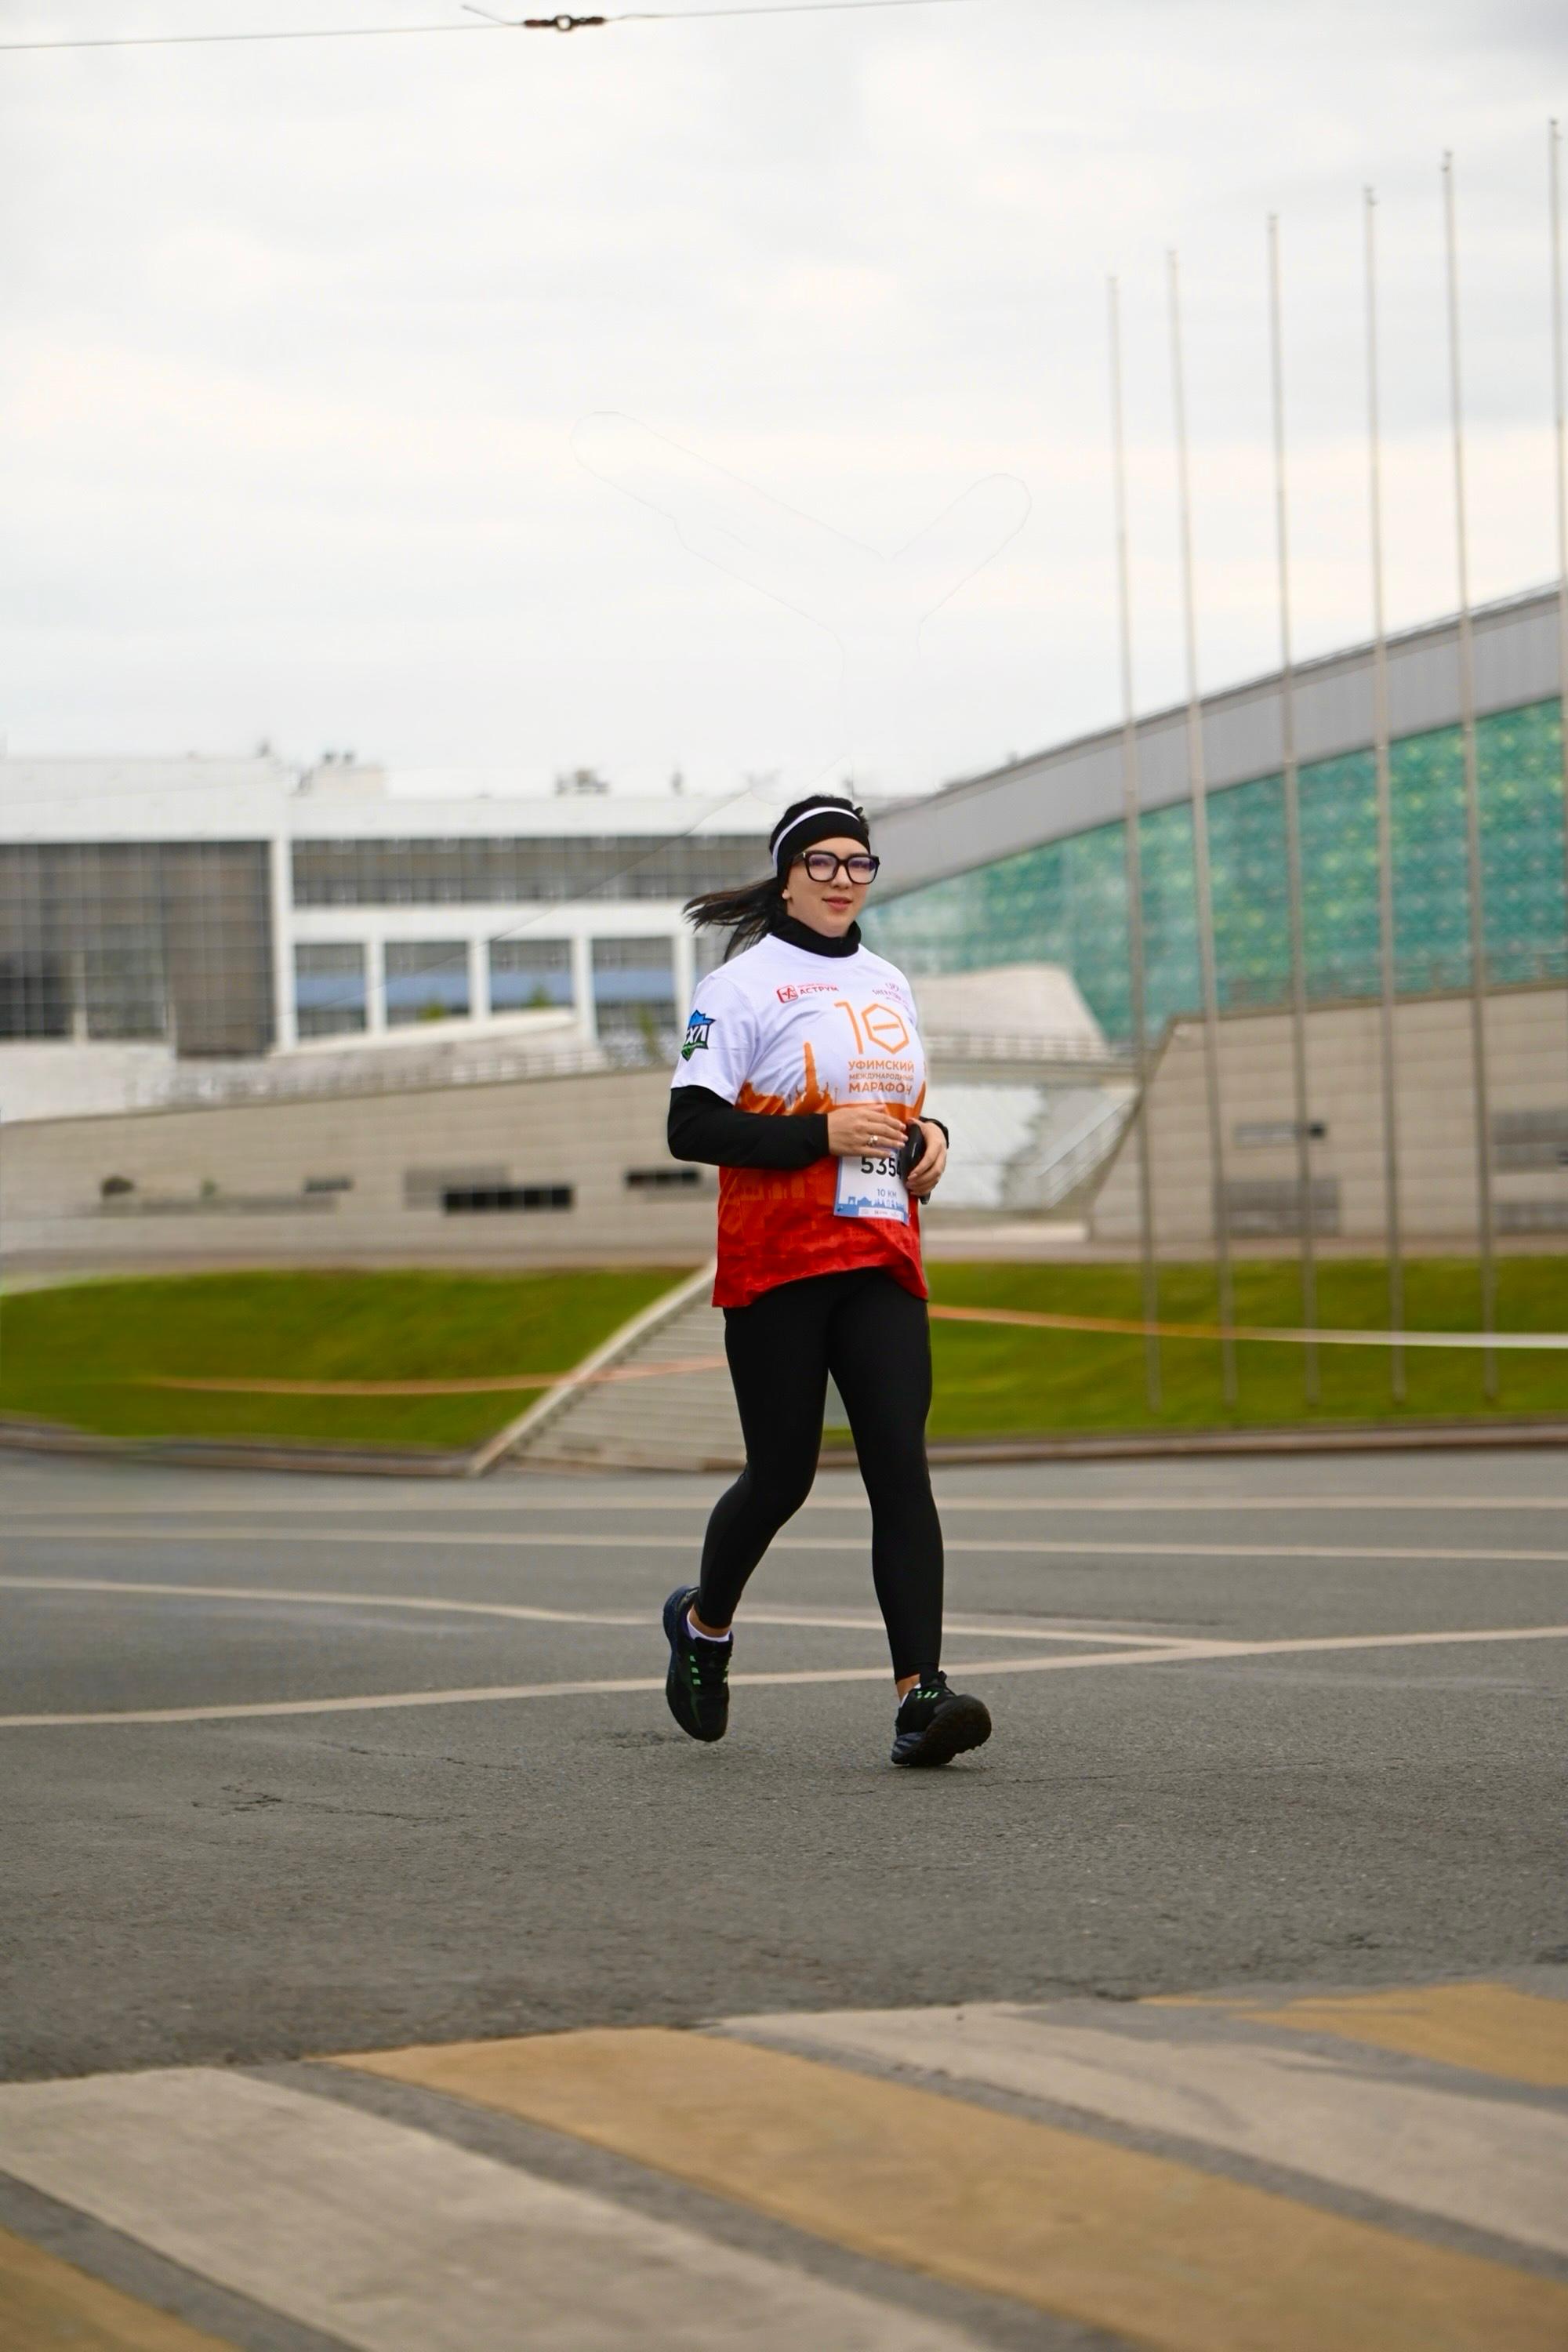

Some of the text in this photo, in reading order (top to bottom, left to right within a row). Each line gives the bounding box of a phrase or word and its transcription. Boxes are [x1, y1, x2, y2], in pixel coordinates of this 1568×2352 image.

[800, 985, 839, 995] АСТРУМ
[848, 1060, 914, 1073] УФИМСКИЙ
[849, 1081, 912, 1095] МАРАФОН
[877, 1189, 885, 1197] 10
